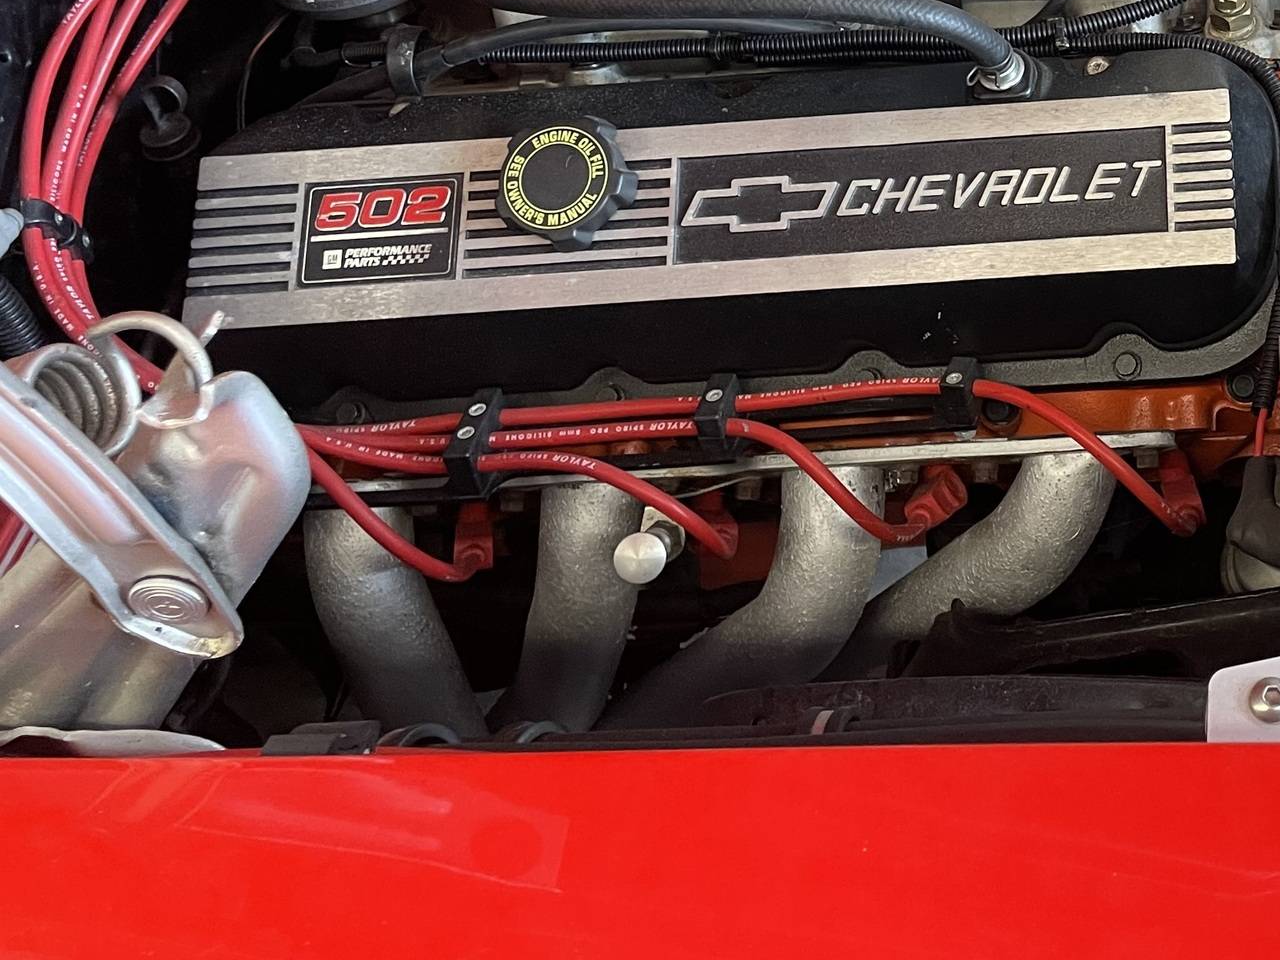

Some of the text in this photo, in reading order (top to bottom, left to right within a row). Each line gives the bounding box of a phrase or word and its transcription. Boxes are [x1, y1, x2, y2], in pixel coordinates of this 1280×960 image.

[531, 130, 604, 179] ENGINE OIL FILL
[506, 155, 598, 226] SEE OWNER'S MANUAL
[836, 159, 1163, 217] CHEVROLET
[314, 186, 452, 232] 502
[344, 243, 433, 259] PERFORMANCE
[344, 256, 381, 269] PARTS
[65, 284, 95, 321] TAYLOR
[370, 419, 418, 433] TAYLOR
[590, 427, 609, 435] PRO
[615, 424, 644, 433] SPIRO
[649, 420, 694, 431] TAYLOR
[505, 431, 552, 441] SILICONE
[375, 449, 404, 460] MADE
[552, 453, 597, 470] TAYLOR
